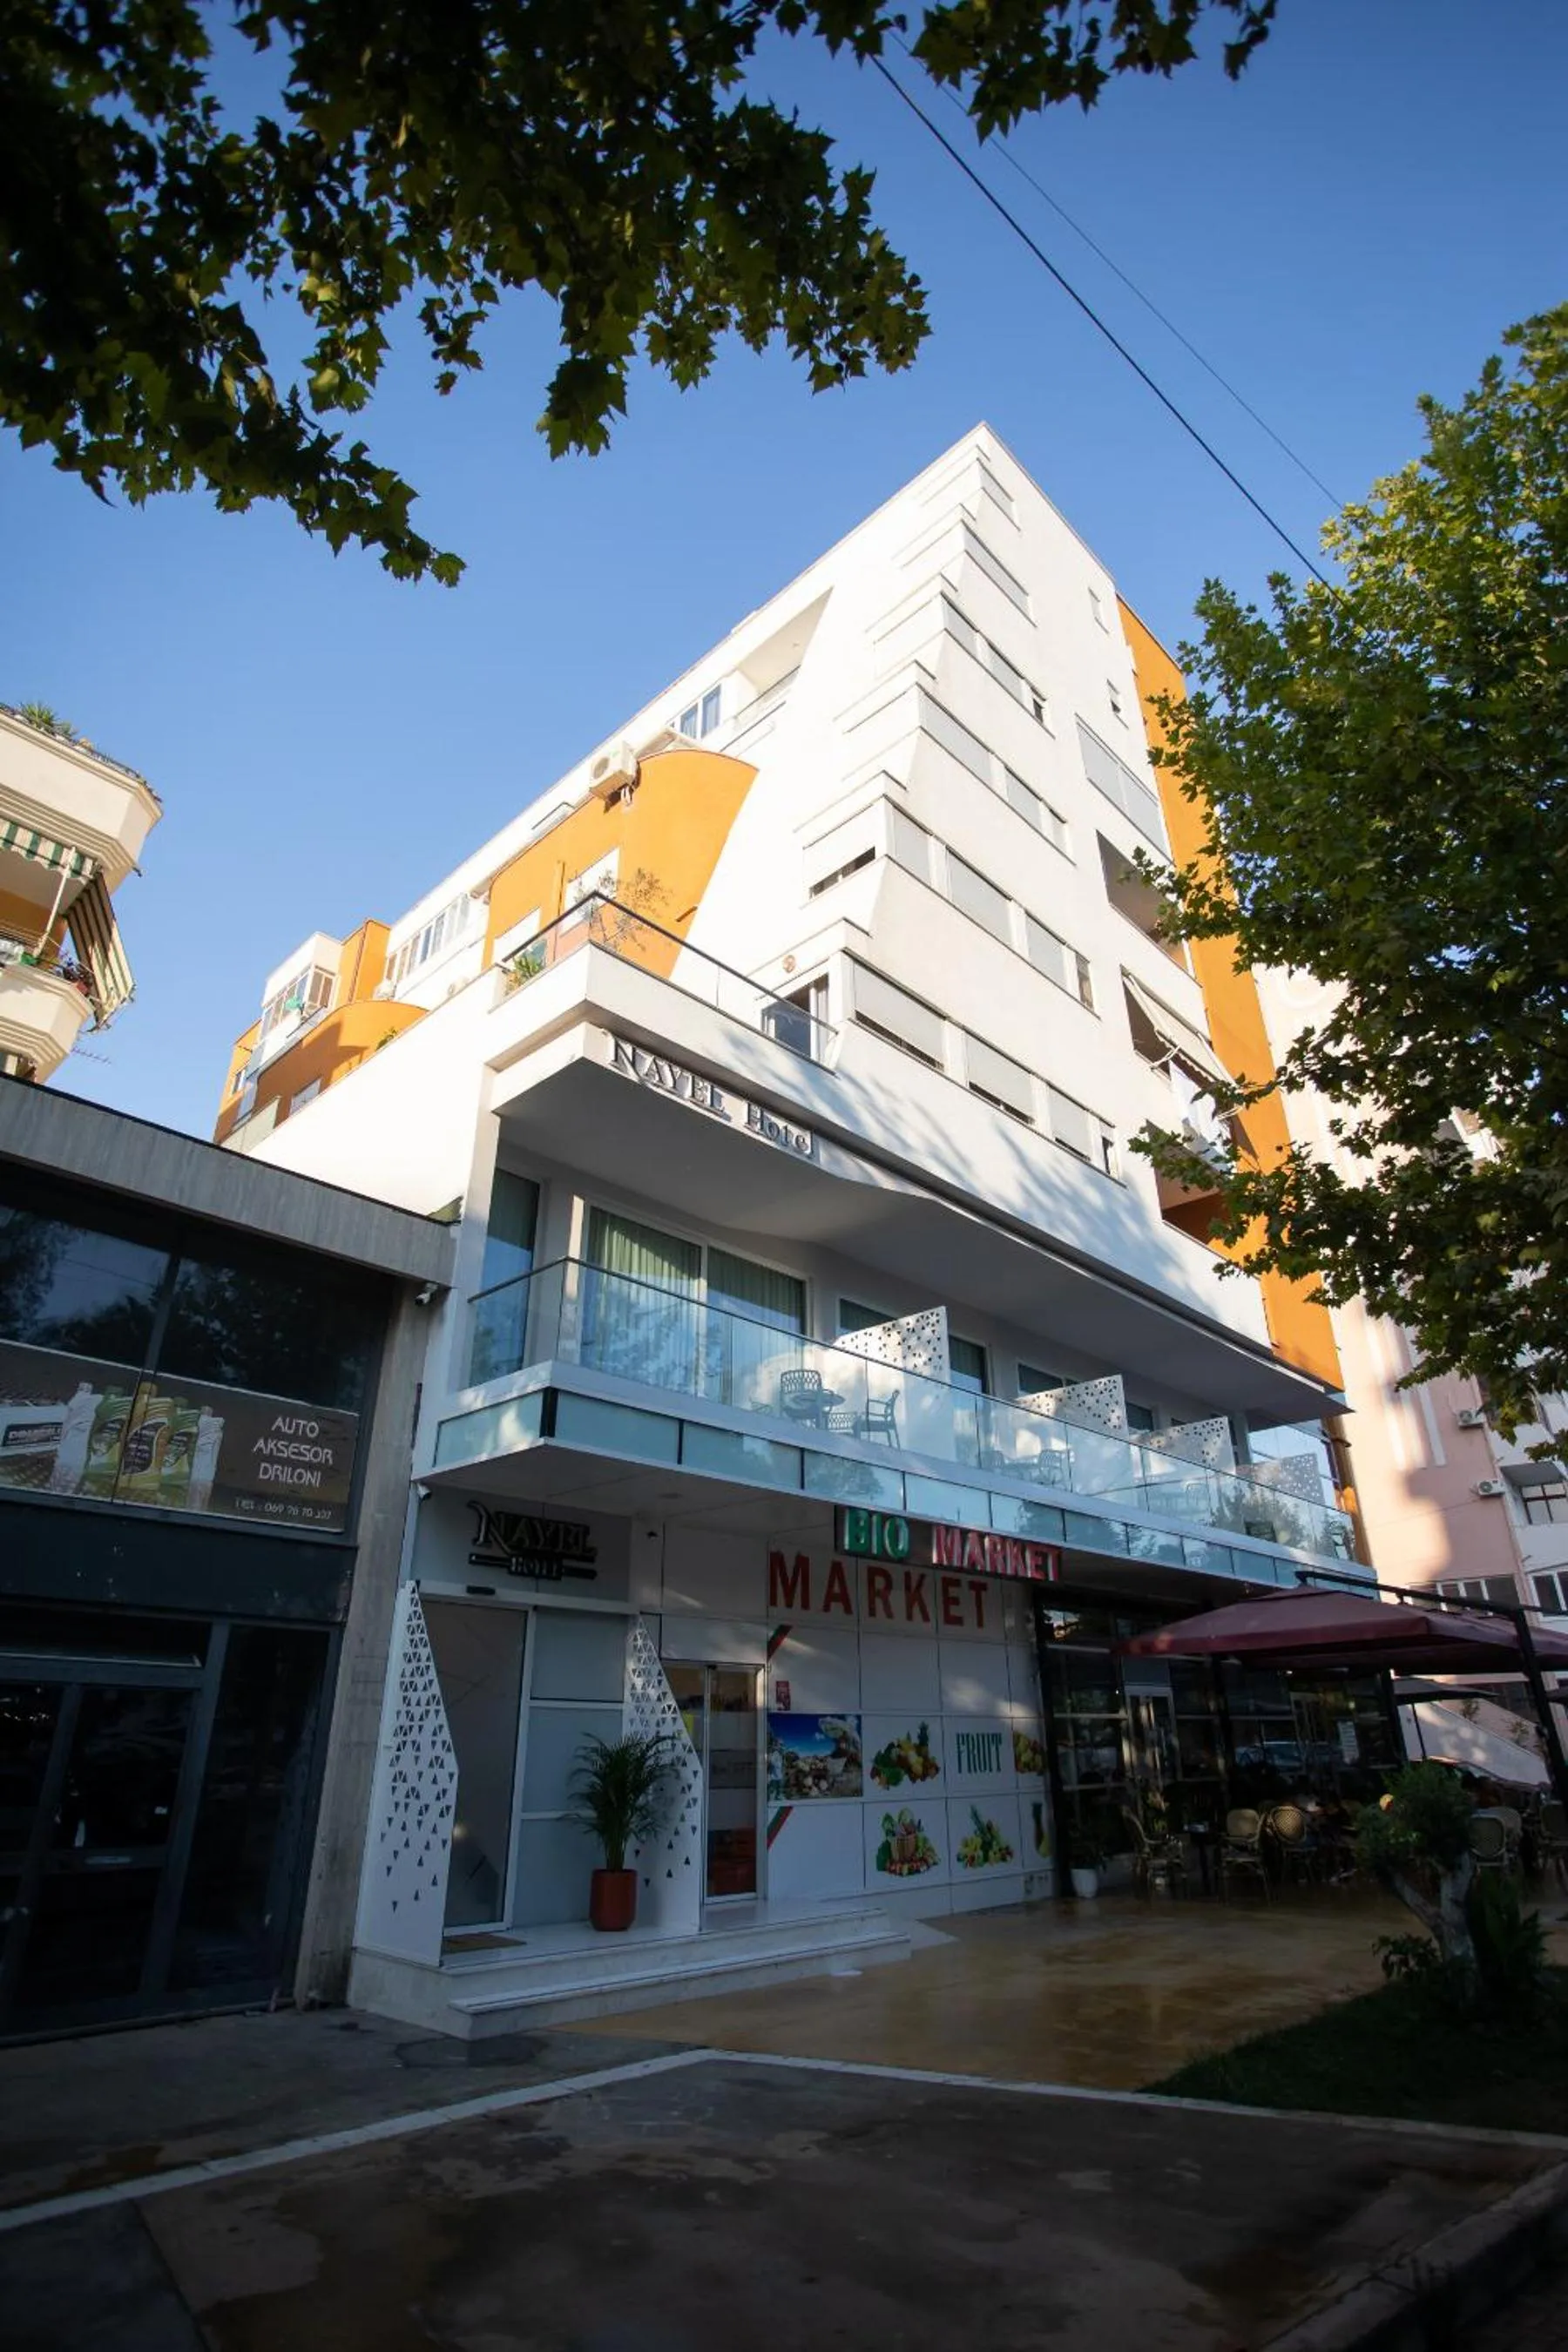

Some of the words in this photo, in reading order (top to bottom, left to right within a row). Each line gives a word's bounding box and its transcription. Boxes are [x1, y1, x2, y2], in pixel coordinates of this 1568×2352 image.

[271, 1416, 319, 1438] AUTO
[252, 1437, 334, 1465] AKSESOR
[259, 1463, 321, 1488] DRILONI
[843, 1508, 910, 1560] BIO
[931, 1524, 1062, 1581] MARKET
[769, 1550, 987, 1629] MARKET
[956, 1733, 1002, 1774] FRUIT
